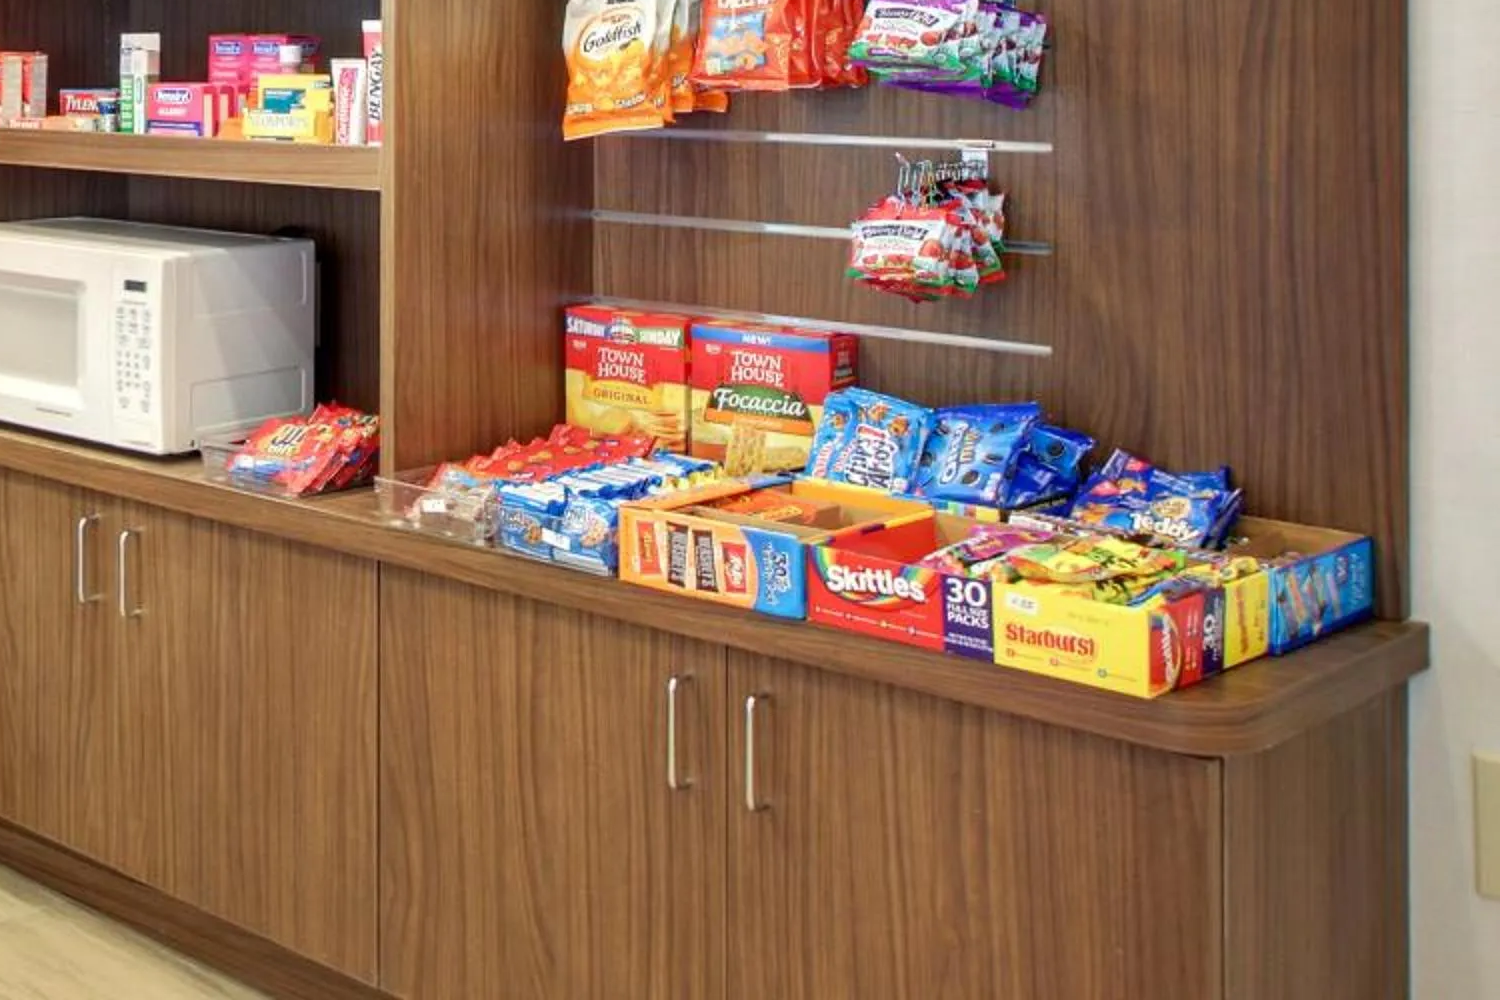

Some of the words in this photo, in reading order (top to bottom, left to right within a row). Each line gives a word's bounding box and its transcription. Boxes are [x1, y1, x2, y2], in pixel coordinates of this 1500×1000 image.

[582, 20, 642, 53] Goldfish
[597, 347, 645, 367] TOWN
[730, 350, 782, 369] TOWN
[597, 363, 646, 383] HOUSE
[731, 366, 784, 388] HOUSE
[593, 387, 649, 405] ORIGINAL
[709, 386, 806, 417] Focaccia
[1129, 511, 1198, 547] Teddy
[826, 564, 925, 602] Skittles
[946, 576, 988, 607] 30
[947, 611, 990, 629] PACKS
[1005, 622, 1096, 660] Starburst
